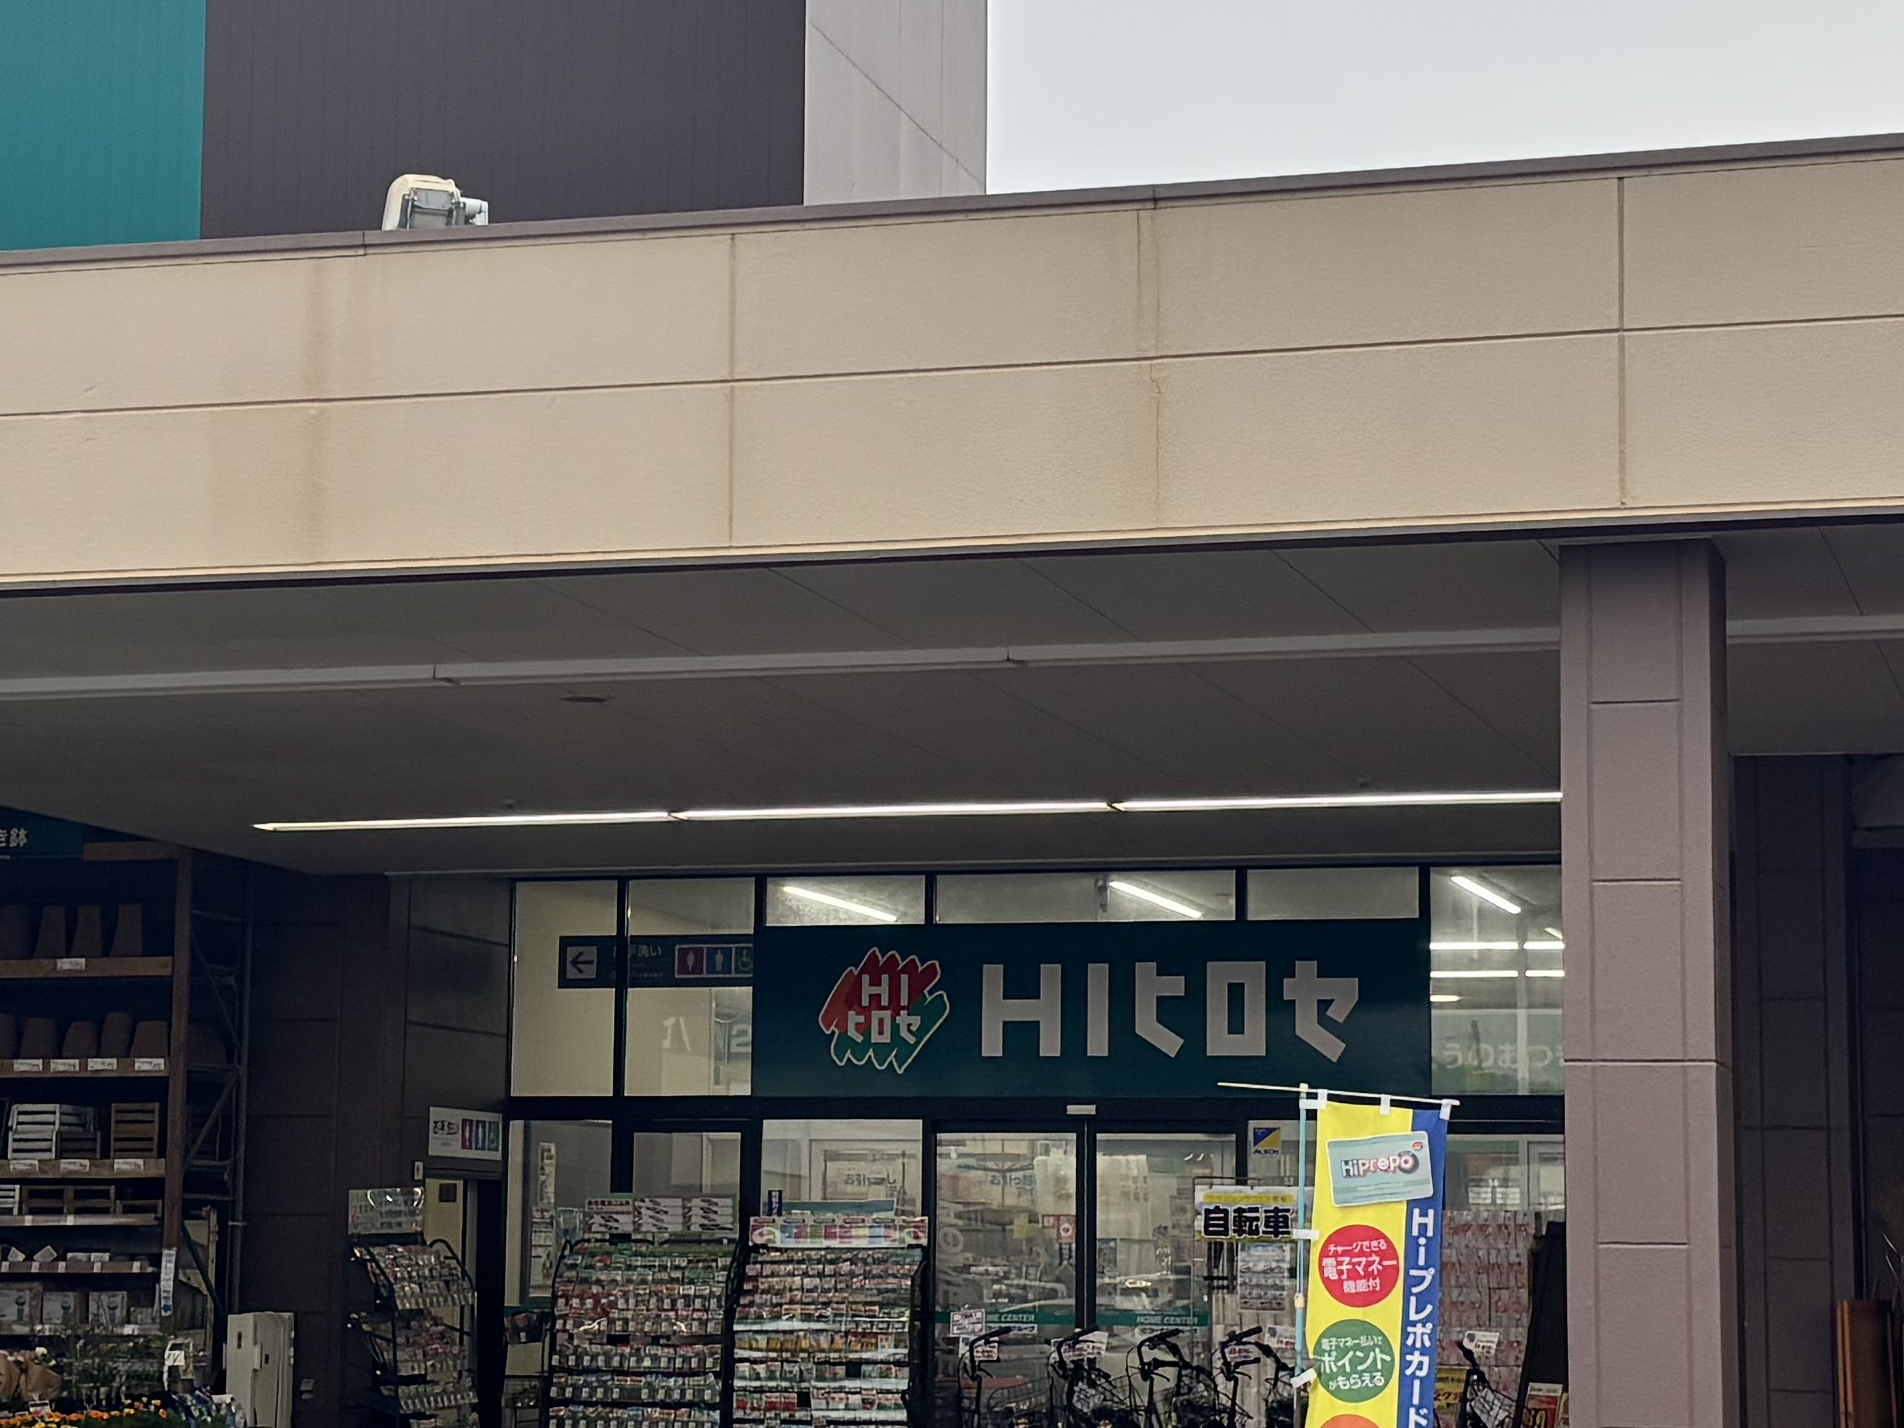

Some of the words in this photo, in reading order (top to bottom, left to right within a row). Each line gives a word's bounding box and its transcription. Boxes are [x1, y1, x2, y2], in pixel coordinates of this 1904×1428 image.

[862, 974, 911, 1007] HI
[847, 1011, 921, 1046] ヒロセ
[1203, 1205, 1292, 1238] 自転車
[1322, 1254, 1397, 1281] 電子マネー
[1320, 1347, 1392, 1374] ポイント
[1329, 1372, 1385, 1391] がもらえる
